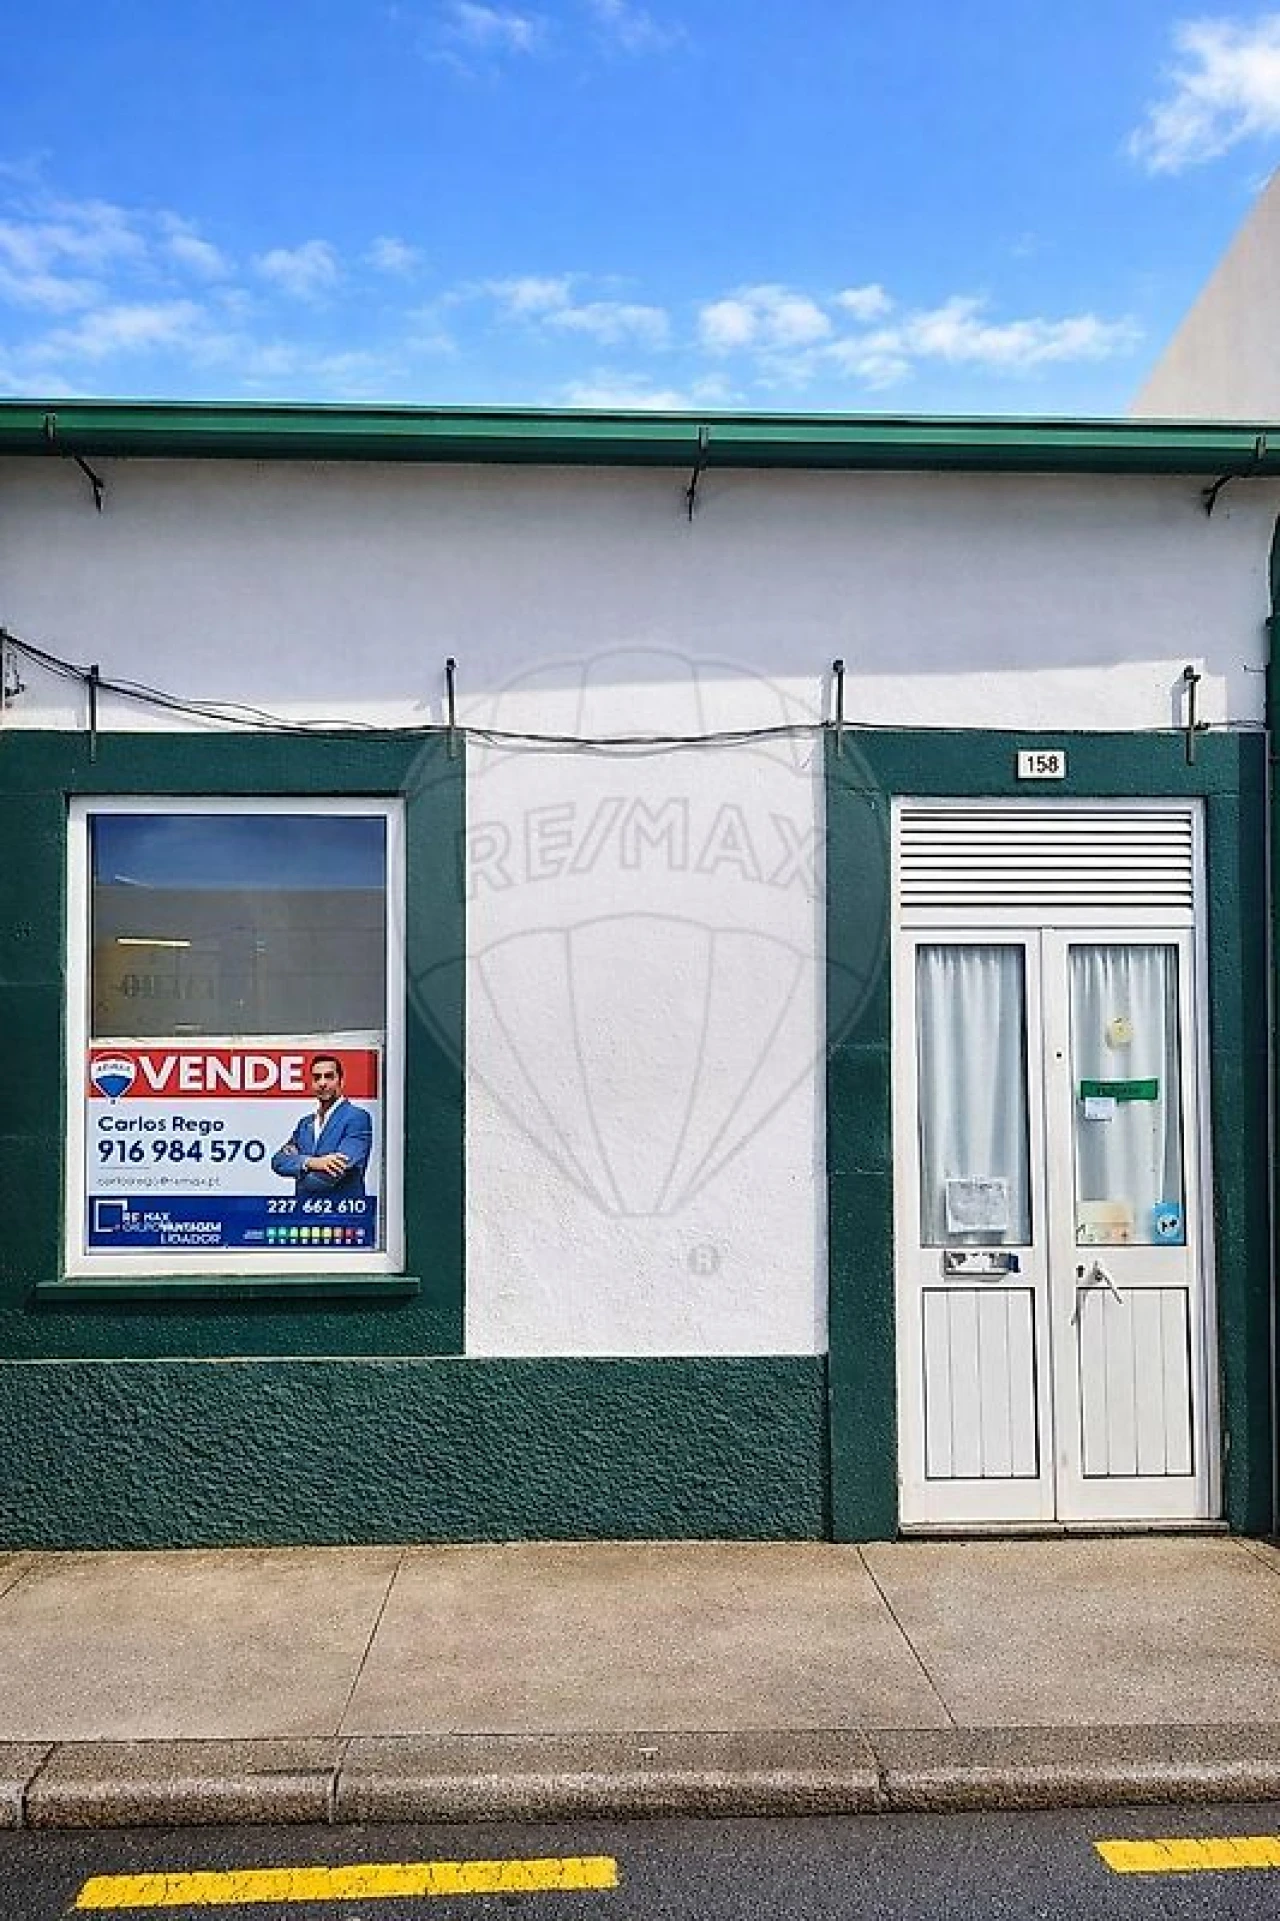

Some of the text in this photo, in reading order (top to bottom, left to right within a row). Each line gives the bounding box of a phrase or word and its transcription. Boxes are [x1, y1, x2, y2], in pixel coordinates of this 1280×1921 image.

[1027, 755, 1060, 774] 158
[138, 1055, 304, 1091] VENDE
[97, 1115, 225, 1136] Carlos Rego
[97, 1139, 266, 1163] 916 984 570
[267, 1198, 366, 1214] 227 662 610
